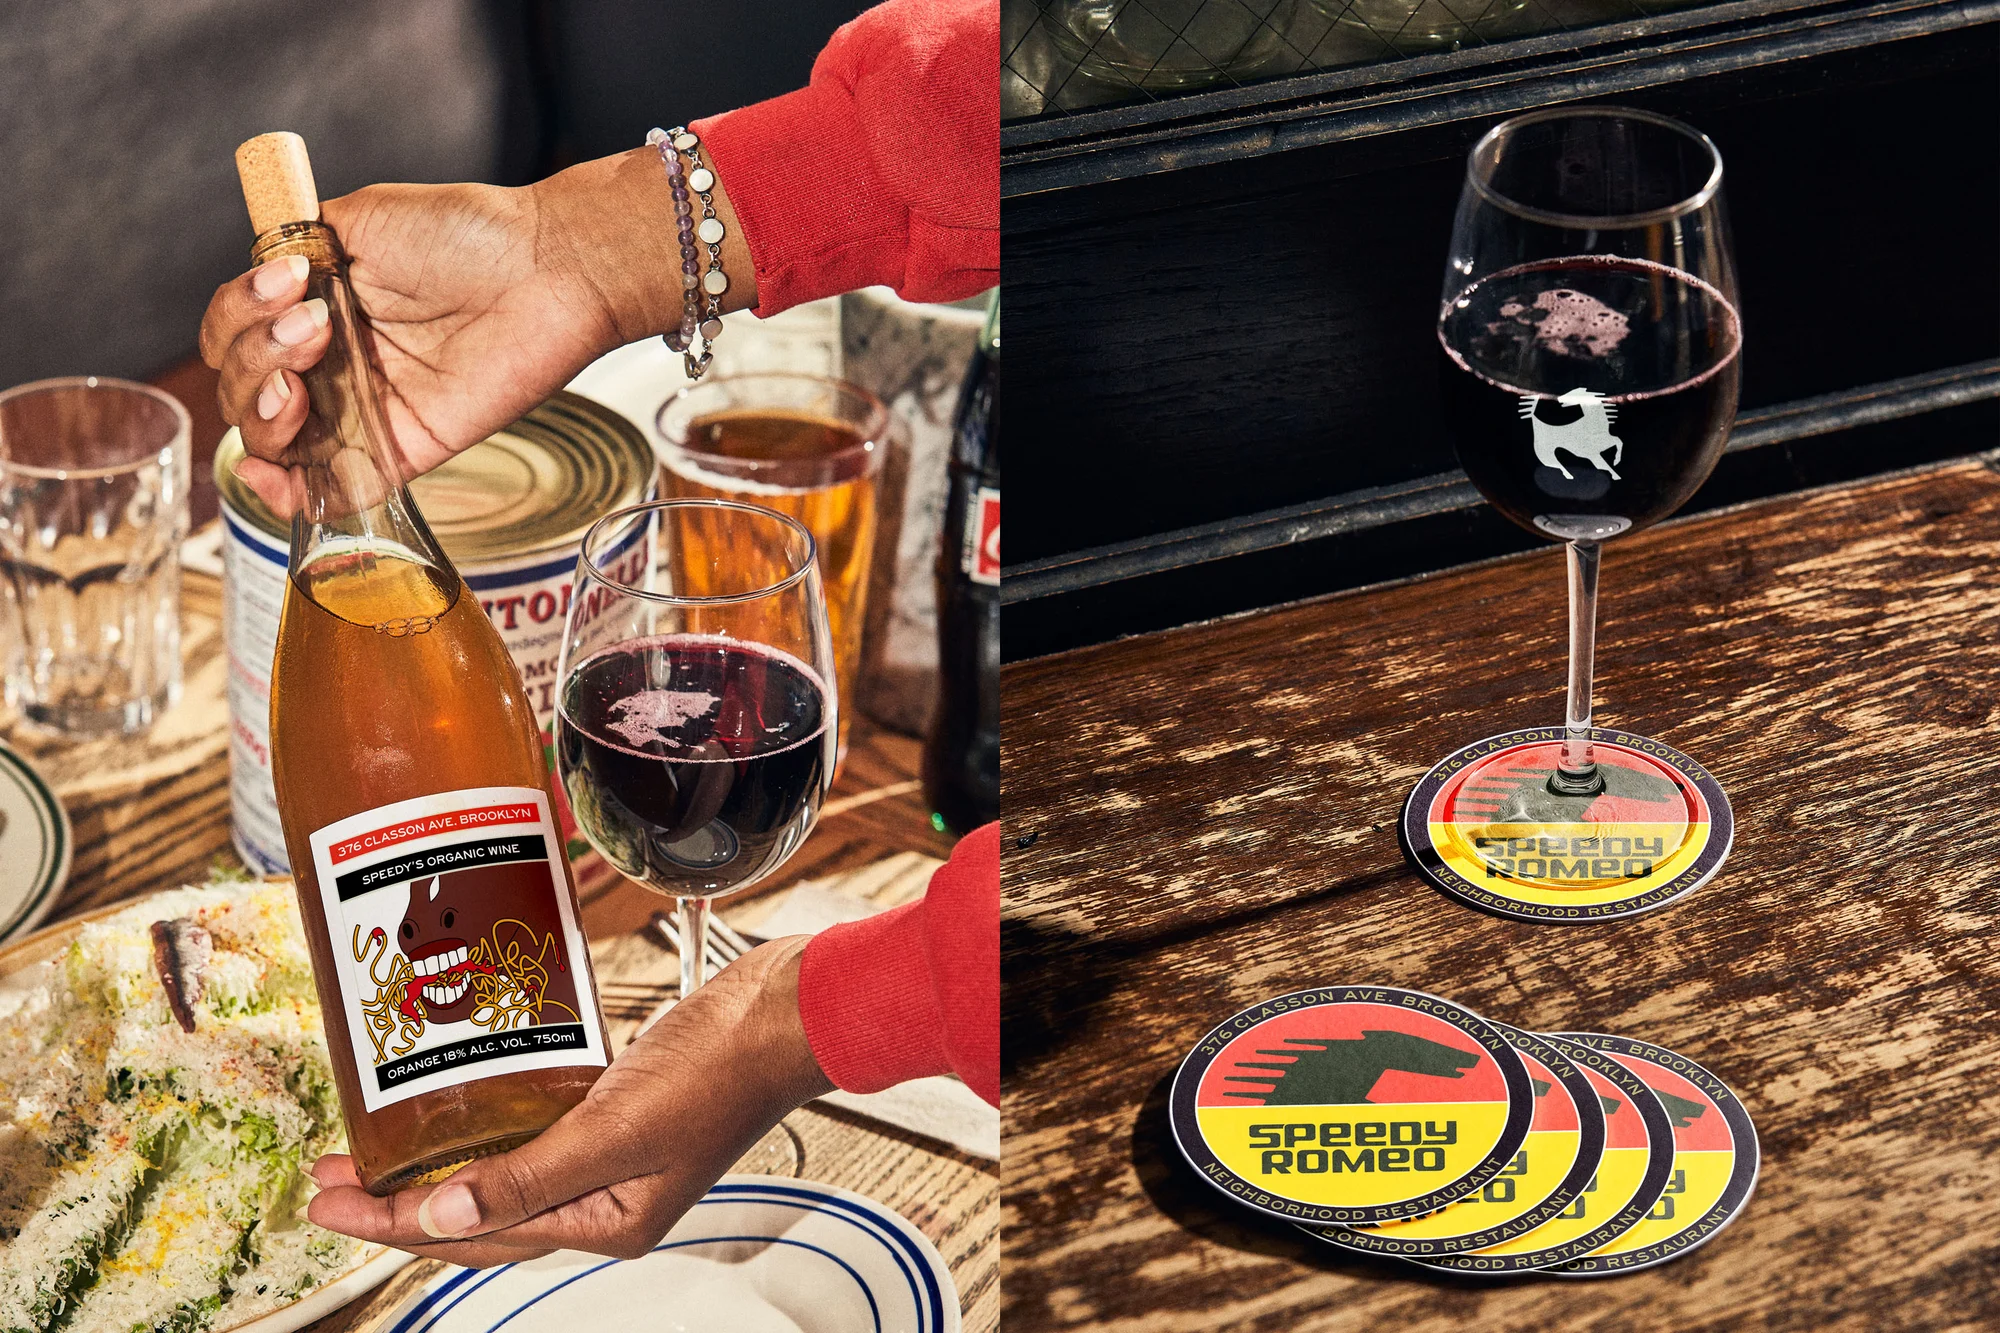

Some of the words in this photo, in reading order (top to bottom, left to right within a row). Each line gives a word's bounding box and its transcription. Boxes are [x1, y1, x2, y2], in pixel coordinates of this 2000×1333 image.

[1433, 756, 1463, 782] 376
[1464, 729, 1555, 761] CLASSON
[1616, 734, 1708, 782] BROOKLYN
[338, 841, 362, 857] 376
[364, 823, 425, 848] CLASSON
[428, 817, 457, 831] AVE.
[459, 808, 532, 825] BROOKLYN
[362, 859, 424, 885] SPEEDY'S
[426, 847, 485, 867] ORGANIC
[487, 843, 520, 856] WINE
[1434, 866, 1580, 918] NEIGHBORHOOD
[1588, 866, 1704, 917] RESTAURANT
[1200, 1029, 1233, 1056] 376
[1235, 991, 1334, 1029] CLASSON
[1343, 990, 1393, 1003] AVE.
[1401, 995, 1504, 1051] BROOKLYN
[387, 1056, 441, 1079] ORANGE
[443, 1048, 467, 1062] 18%
[469, 1042, 499, 1056] ALC.
[500, 1037, 531, 1049] VOL.
[533, 1032, 576, 1044] 750ml
[1628, 1044, 1728, 1101] BROOKLYN
[1204, 1161, 1366, 1221] NEIGHBORHOOD
[1375, 1156, 1503, 1219] RESTAURANT
[1445, 1187, 1573, 1251] RESTAURANT
[1515, 1204, 1644, 1268] RESTAURANT
[1607, 1205, 1730, 1268] RESTAURANT
